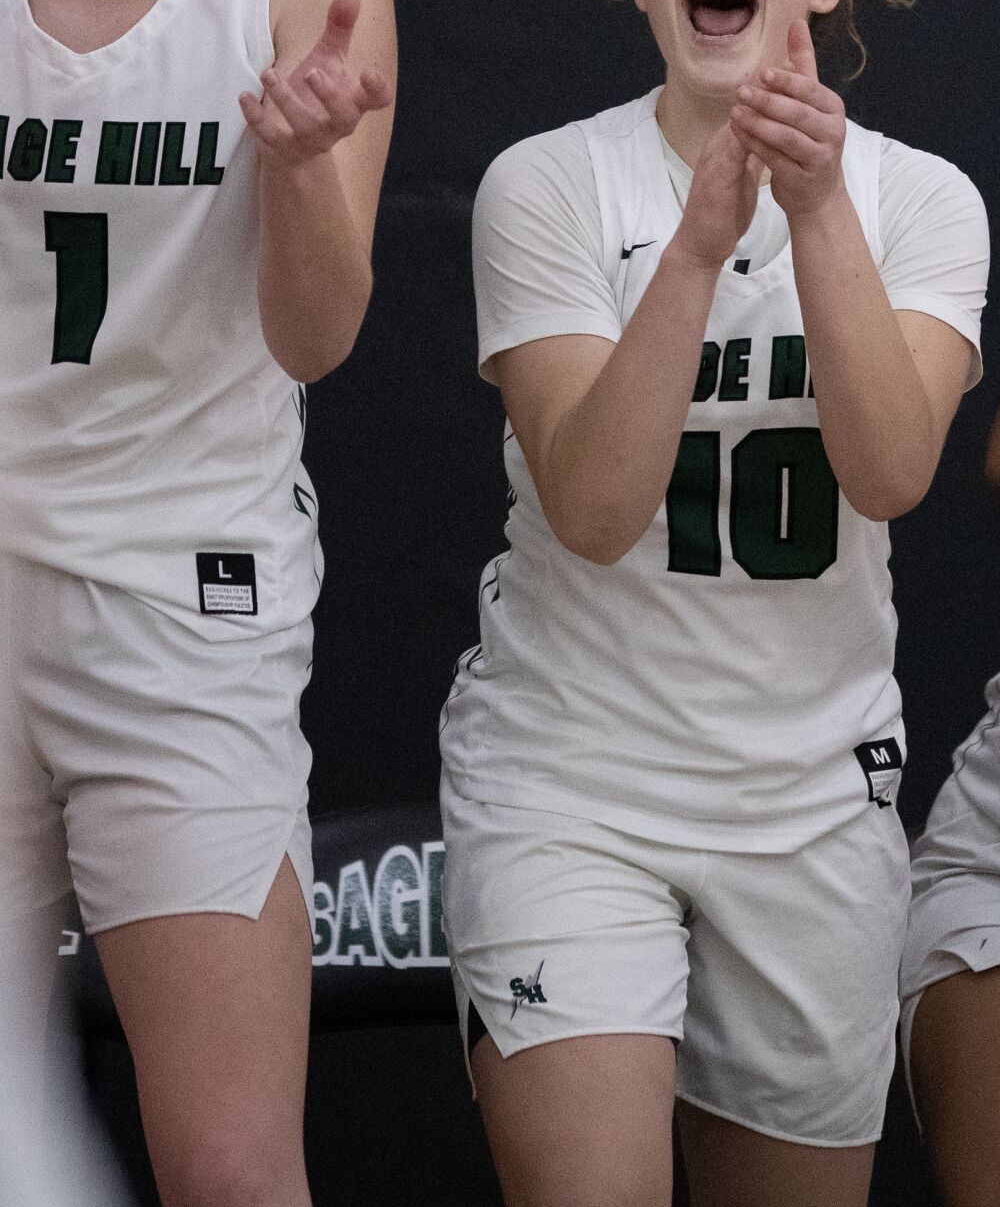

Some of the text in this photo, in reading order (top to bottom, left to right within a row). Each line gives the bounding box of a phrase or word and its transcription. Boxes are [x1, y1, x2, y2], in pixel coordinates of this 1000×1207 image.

[94, 120, 226, 186] HILL
[43, 210, 109, 366] 1
[665, 427, 840, 580] 10
[218, 560, 232, 579] L
[870, 747, 891, 765] M
[509, 977, 548, 1004] SH
